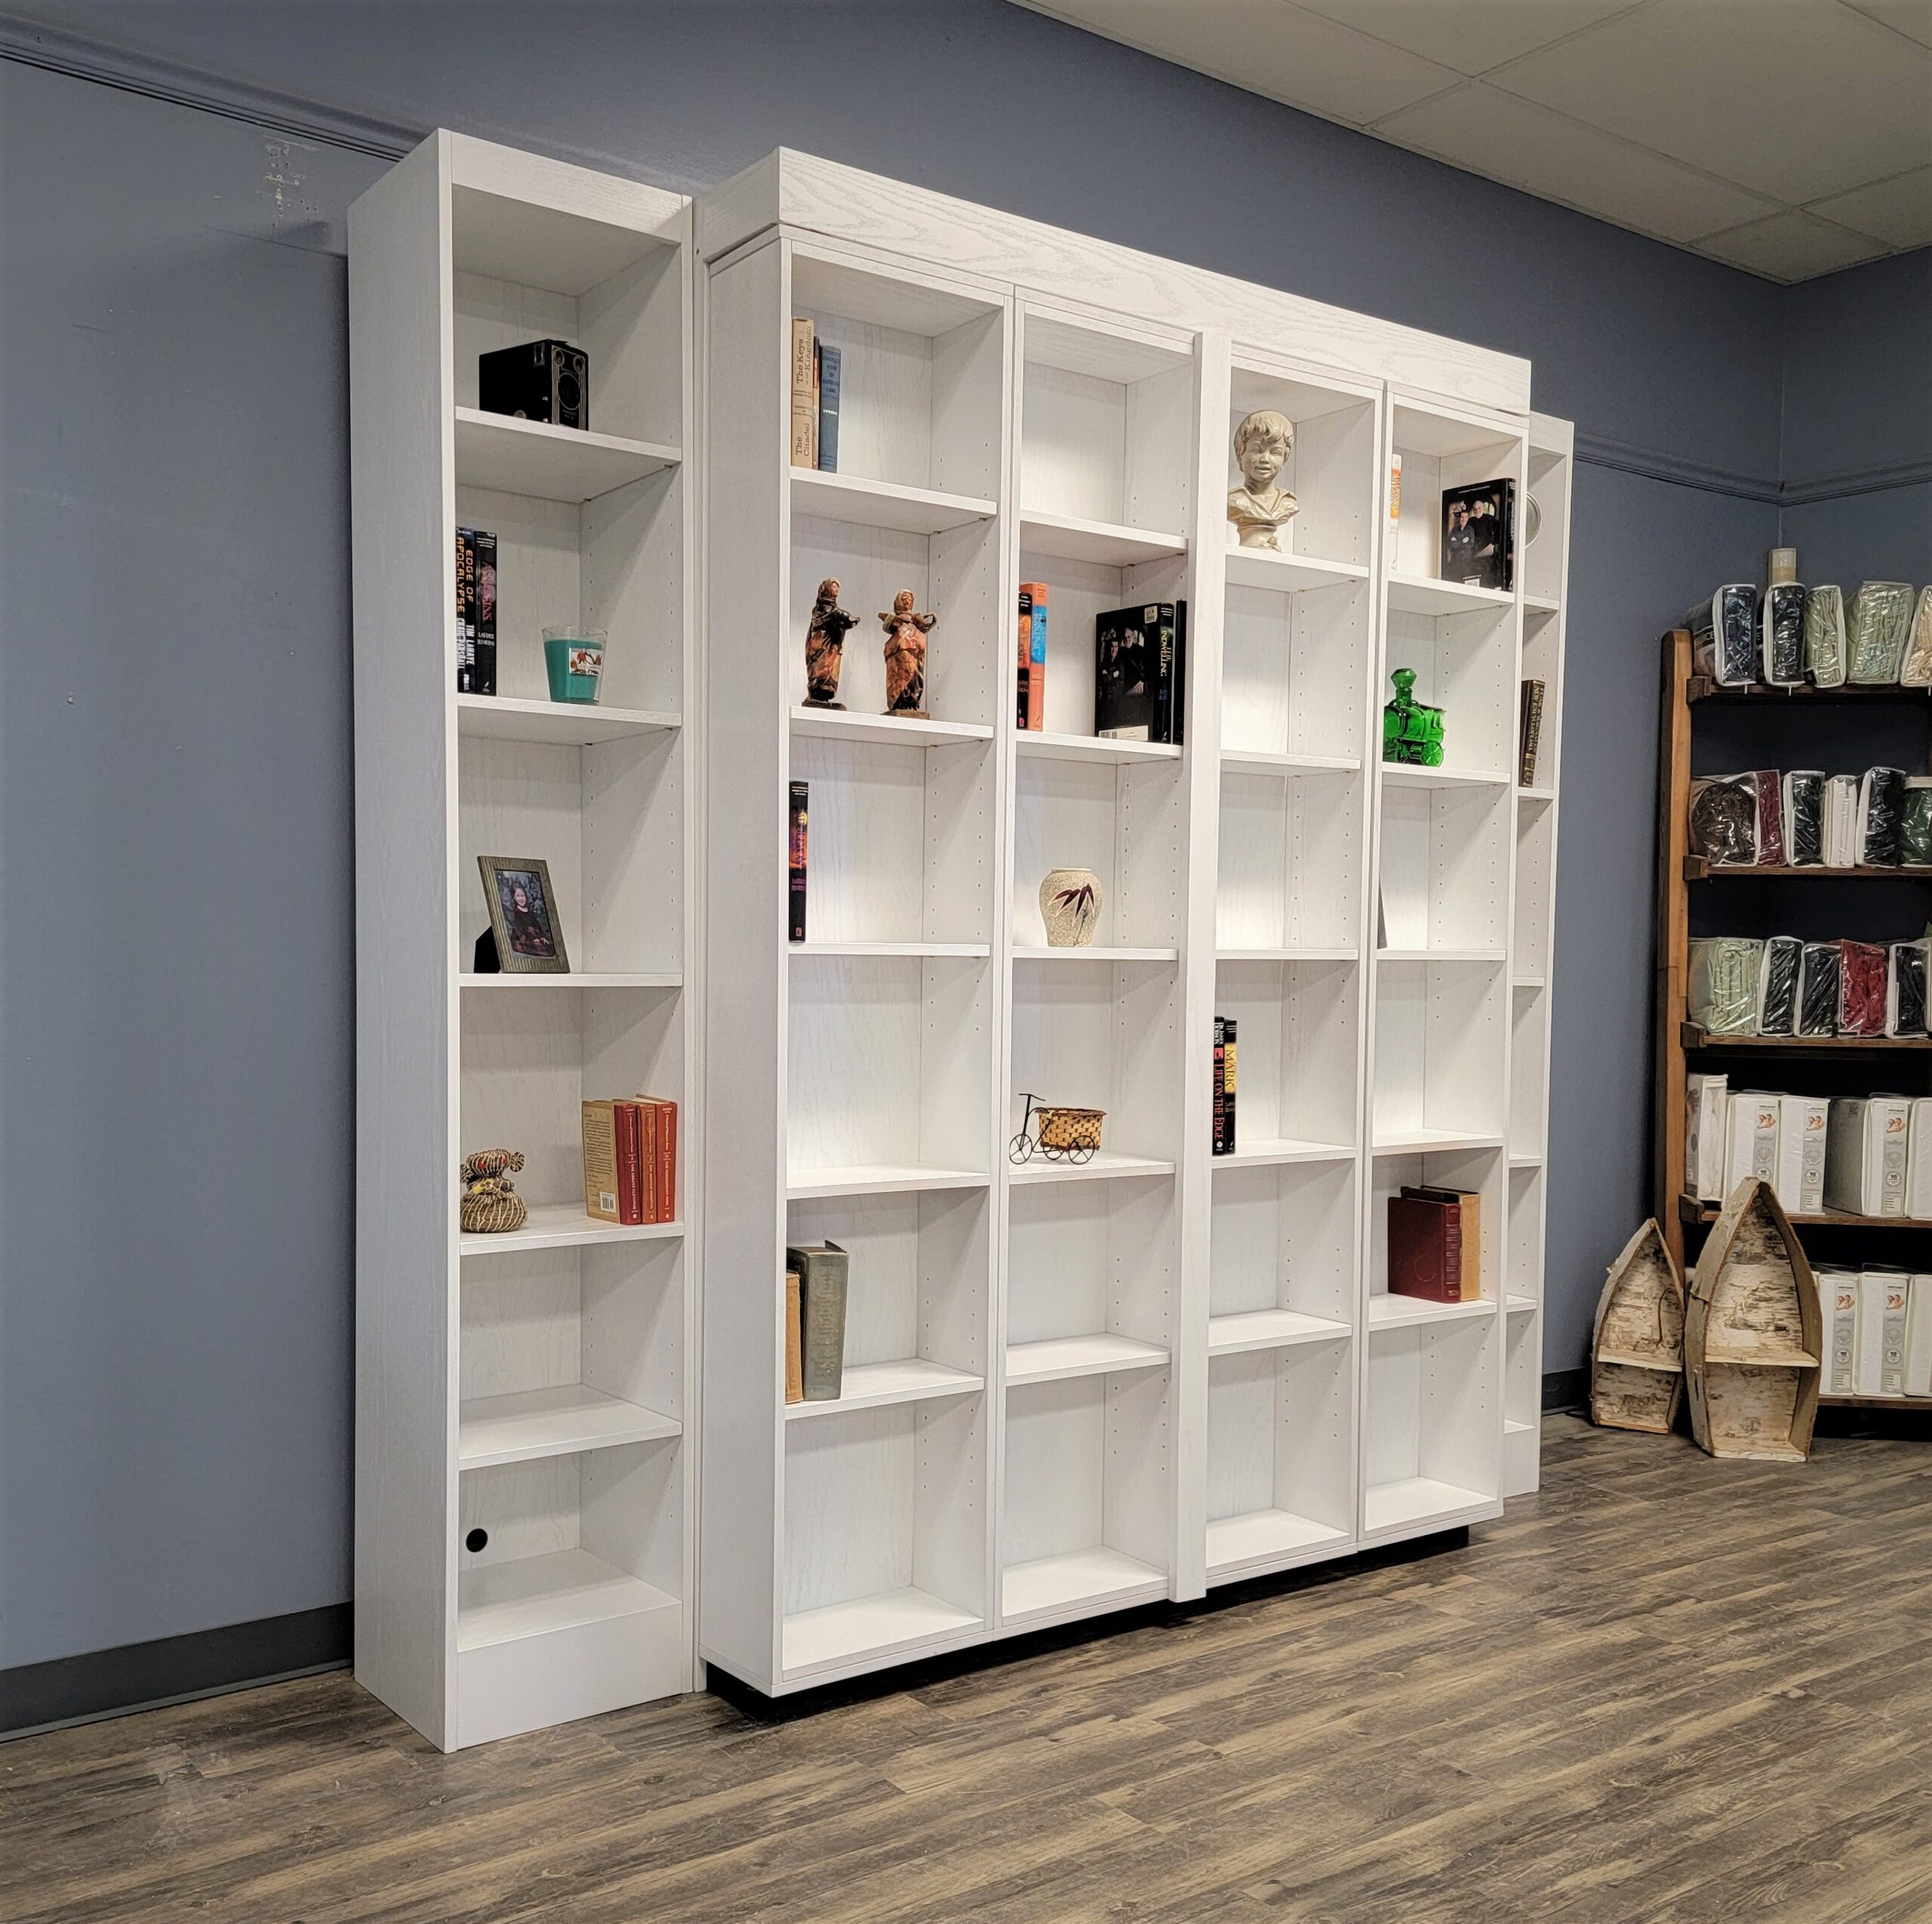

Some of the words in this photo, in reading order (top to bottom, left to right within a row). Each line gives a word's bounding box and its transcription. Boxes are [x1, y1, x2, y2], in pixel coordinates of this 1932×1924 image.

[797, 338, 805, 363] Keys
[457, 537, 465, 613] APOCALYPSE
[466, 586, 474, 602] OF
[466, 624, 475, 636] TIM
[1226, 1049, 1235, 1087] MARK
[1214, 1083, 1223, 1096] ON
[1214, 1097, 1223, 1114] THE
[1214, 1117, 1225, 1140] EDGE
